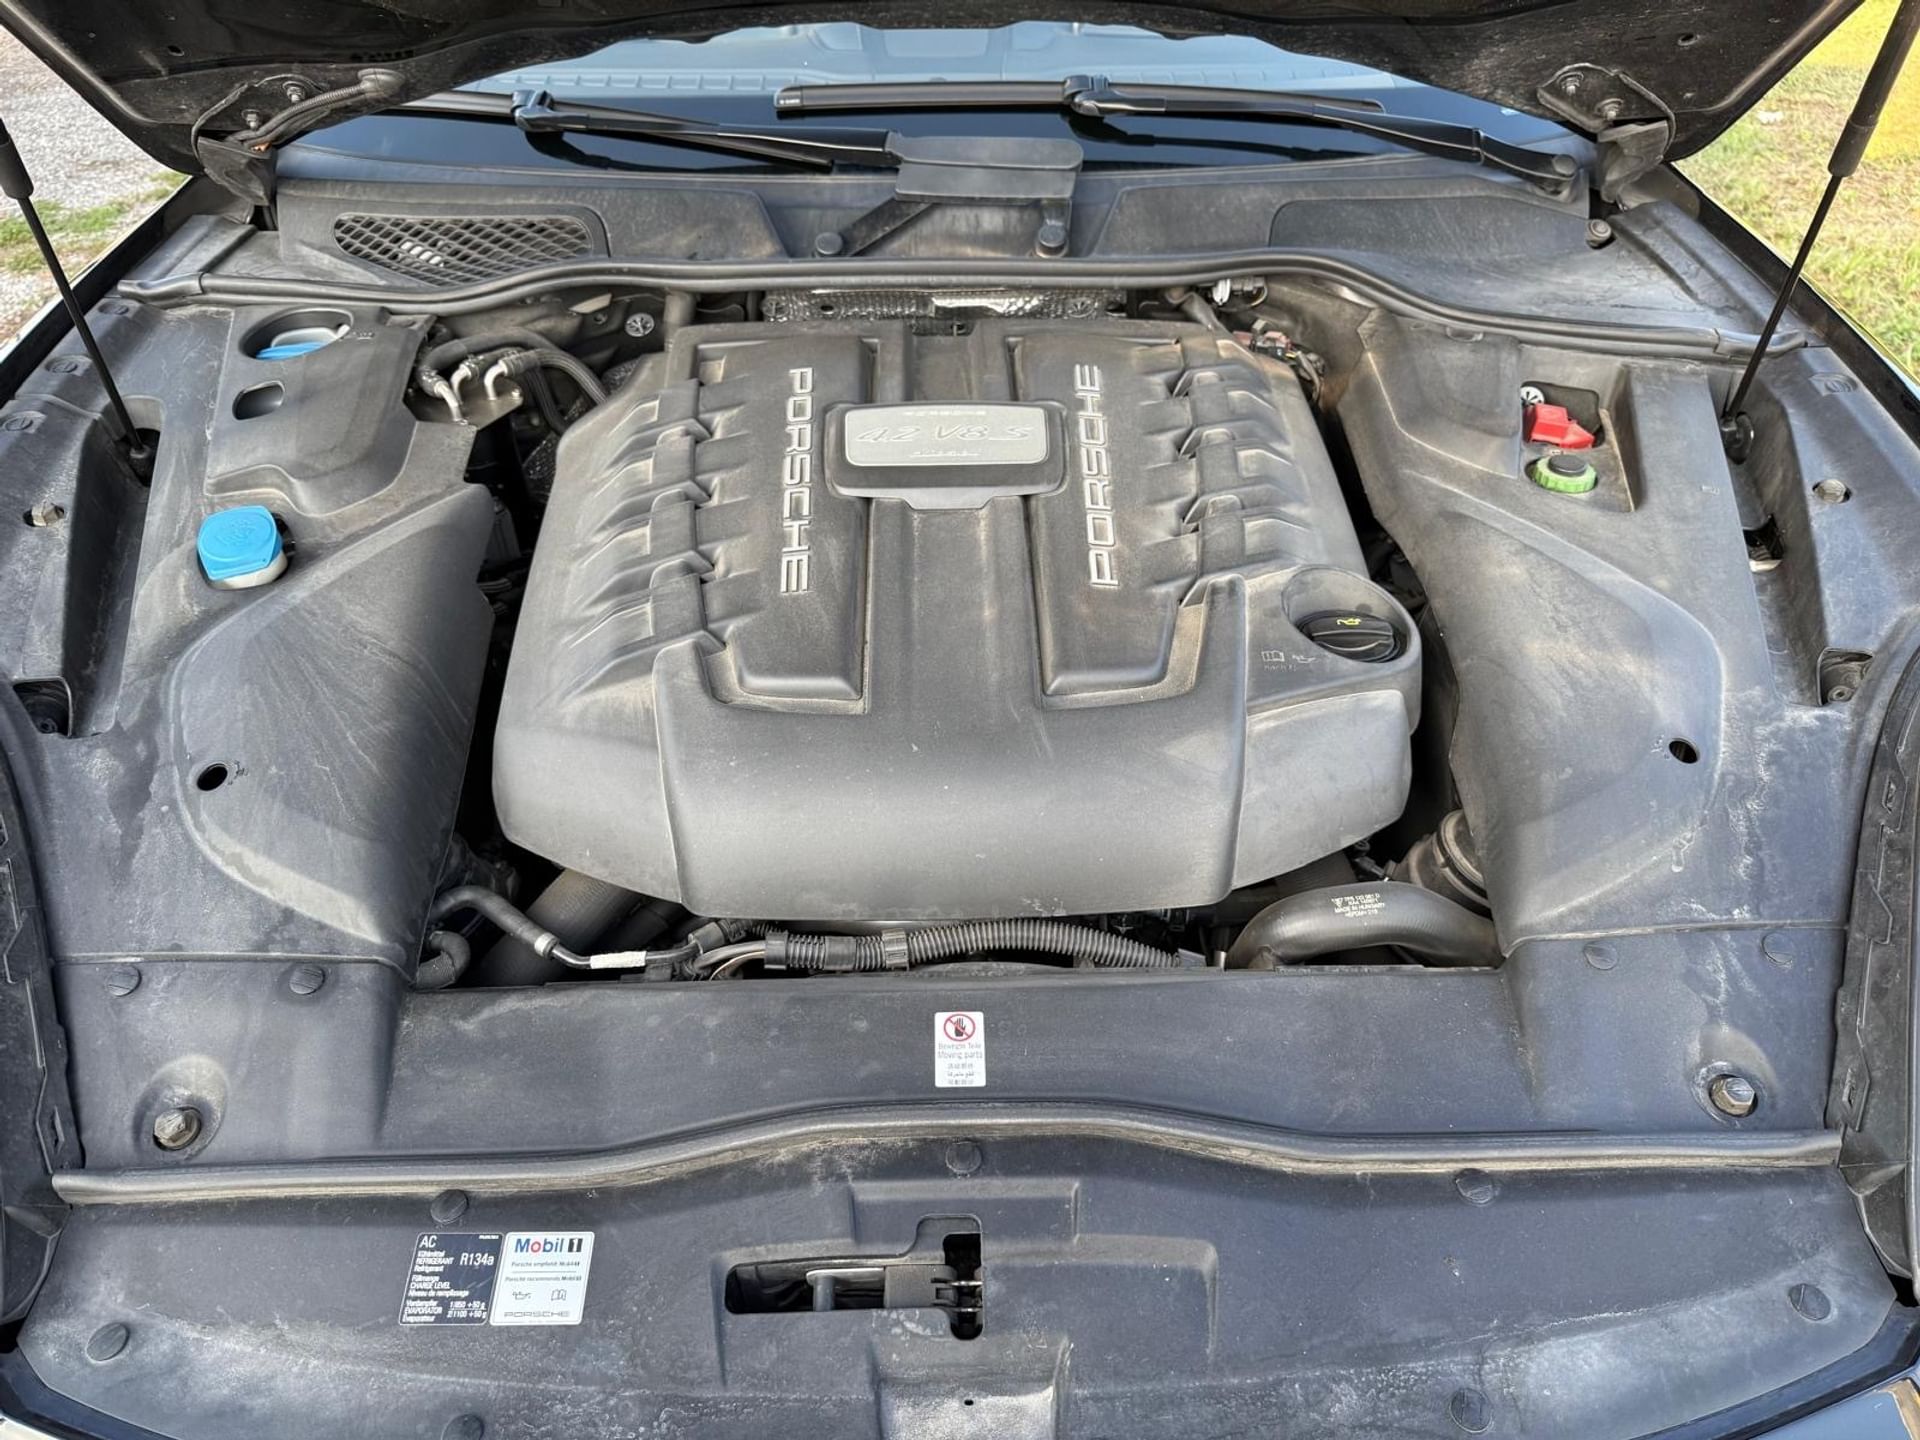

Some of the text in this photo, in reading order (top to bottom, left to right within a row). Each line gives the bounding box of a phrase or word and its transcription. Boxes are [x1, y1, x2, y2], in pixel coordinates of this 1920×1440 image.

[856, 425, 921, 442] 4.2
[934, 424, 989, 441] V8
[780, 367, 813, 593] PORSCHE
[1074, 364, 1119, 586] PORSCHE
[419, 1235, 437, 1248] AC
[515, 1238, 583, 1253] Mobil 1
[459, 1252, 495, 1266] R134a
